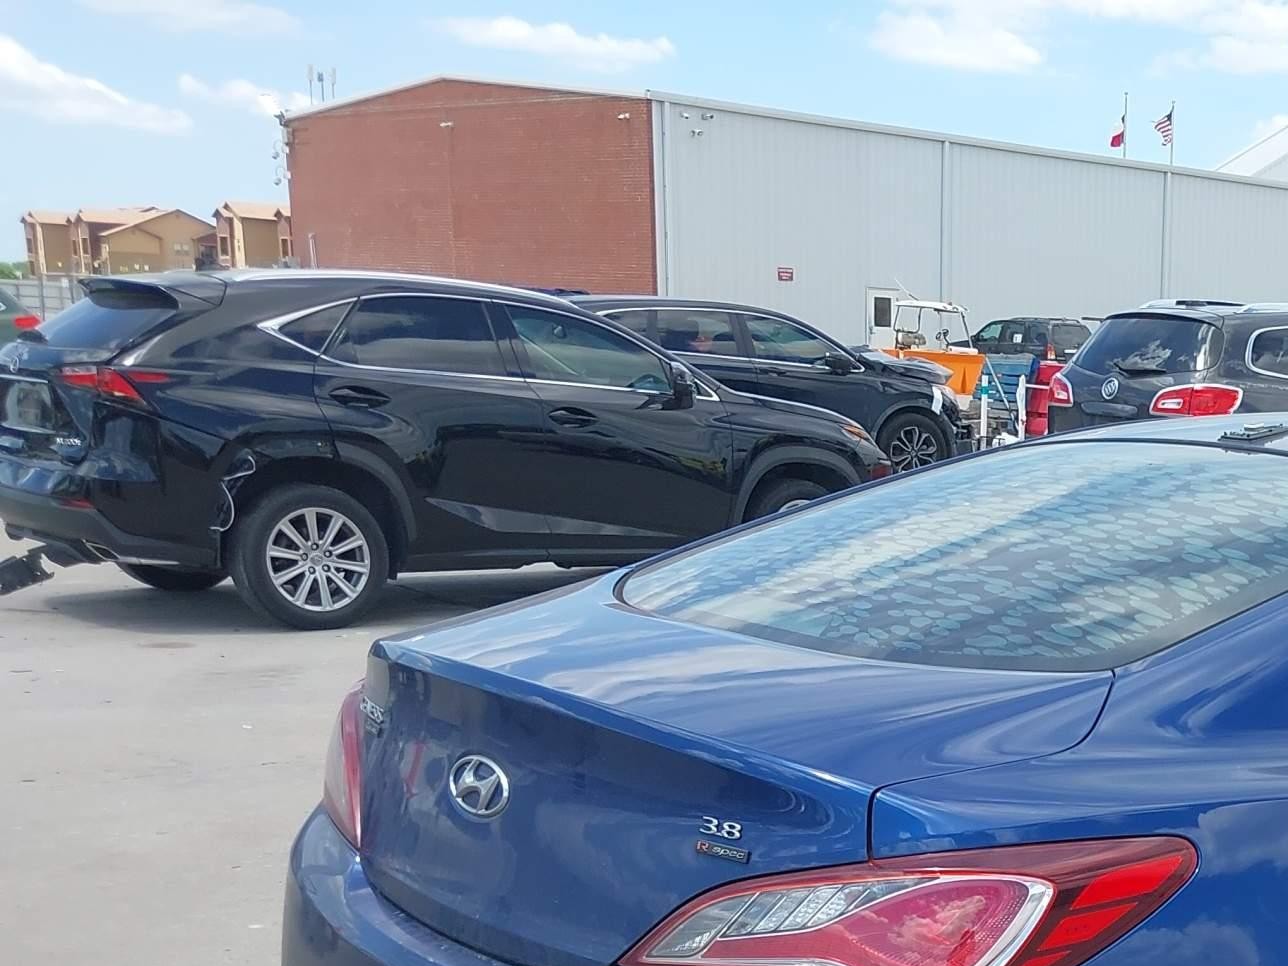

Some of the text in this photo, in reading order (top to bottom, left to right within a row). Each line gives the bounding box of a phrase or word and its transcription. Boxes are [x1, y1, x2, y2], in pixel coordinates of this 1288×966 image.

[699, 815, 742, 840] 3.8
[696, 840, 745, 859] R spec
